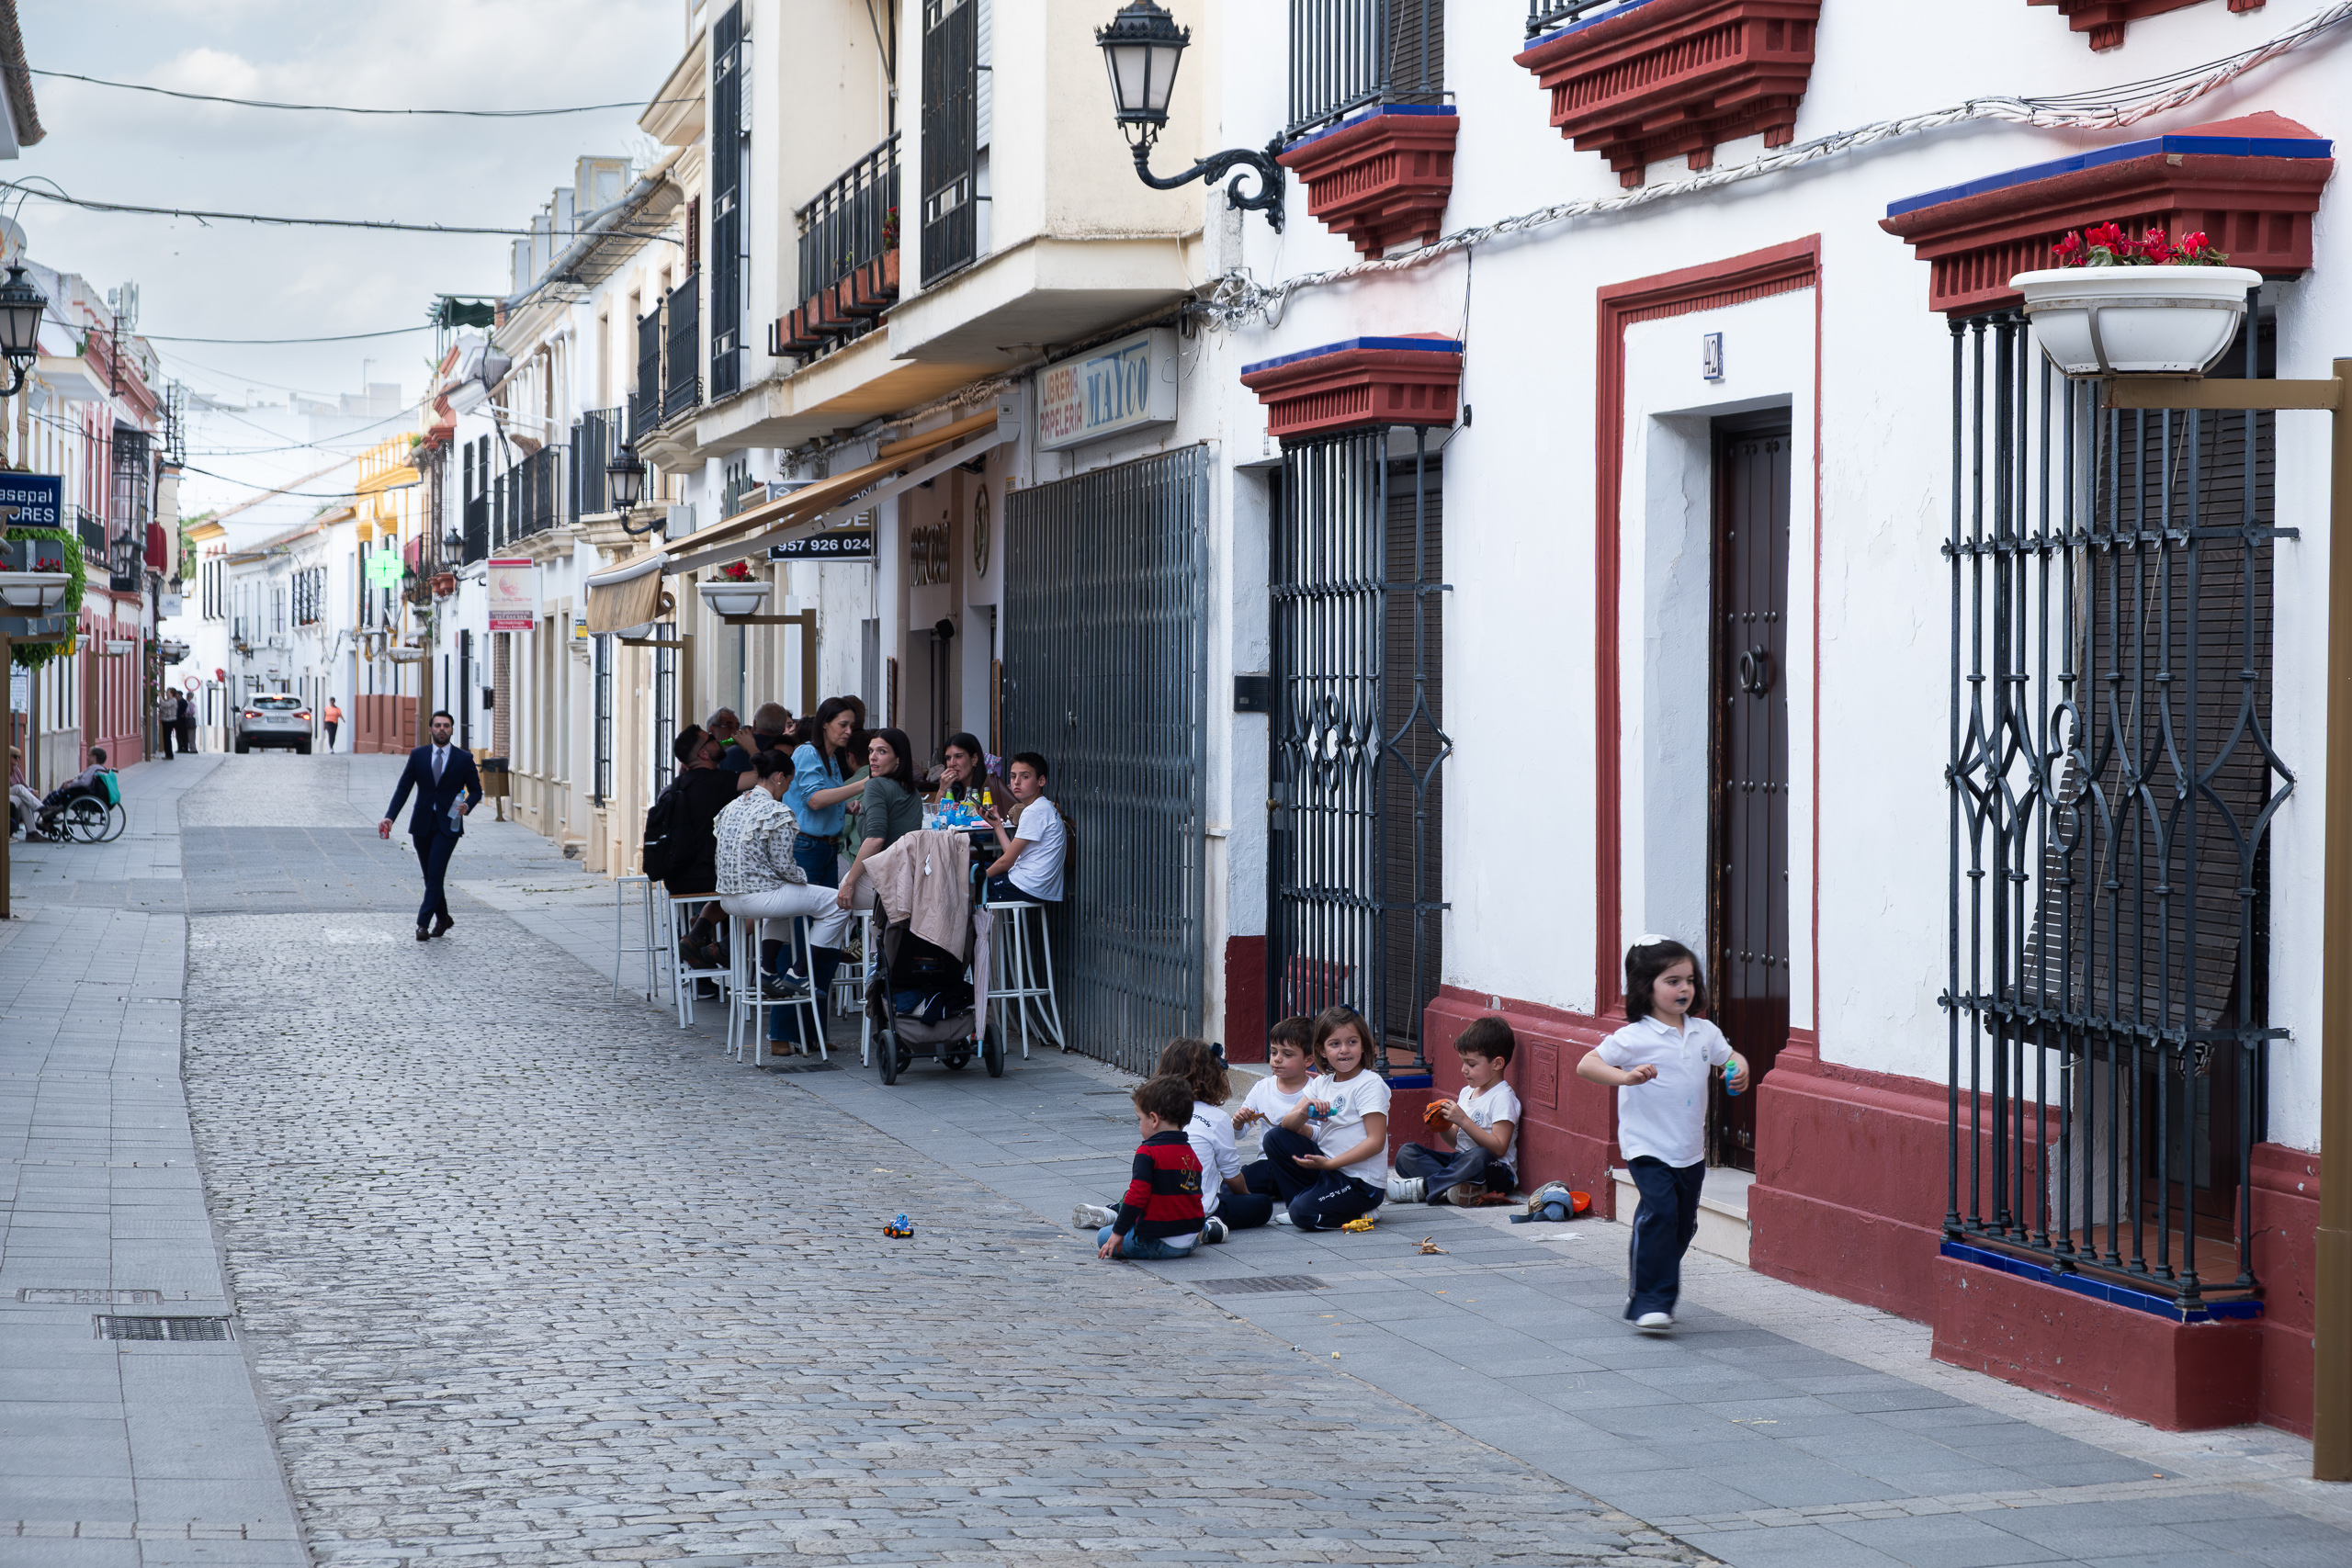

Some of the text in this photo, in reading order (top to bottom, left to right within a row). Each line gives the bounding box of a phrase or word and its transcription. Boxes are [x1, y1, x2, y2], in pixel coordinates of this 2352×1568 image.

[1704, 339, 1717, 375] 42
[1086, 341, 1148, 429] MAYCO
[777, 538, 871, 551] 957 926 024
